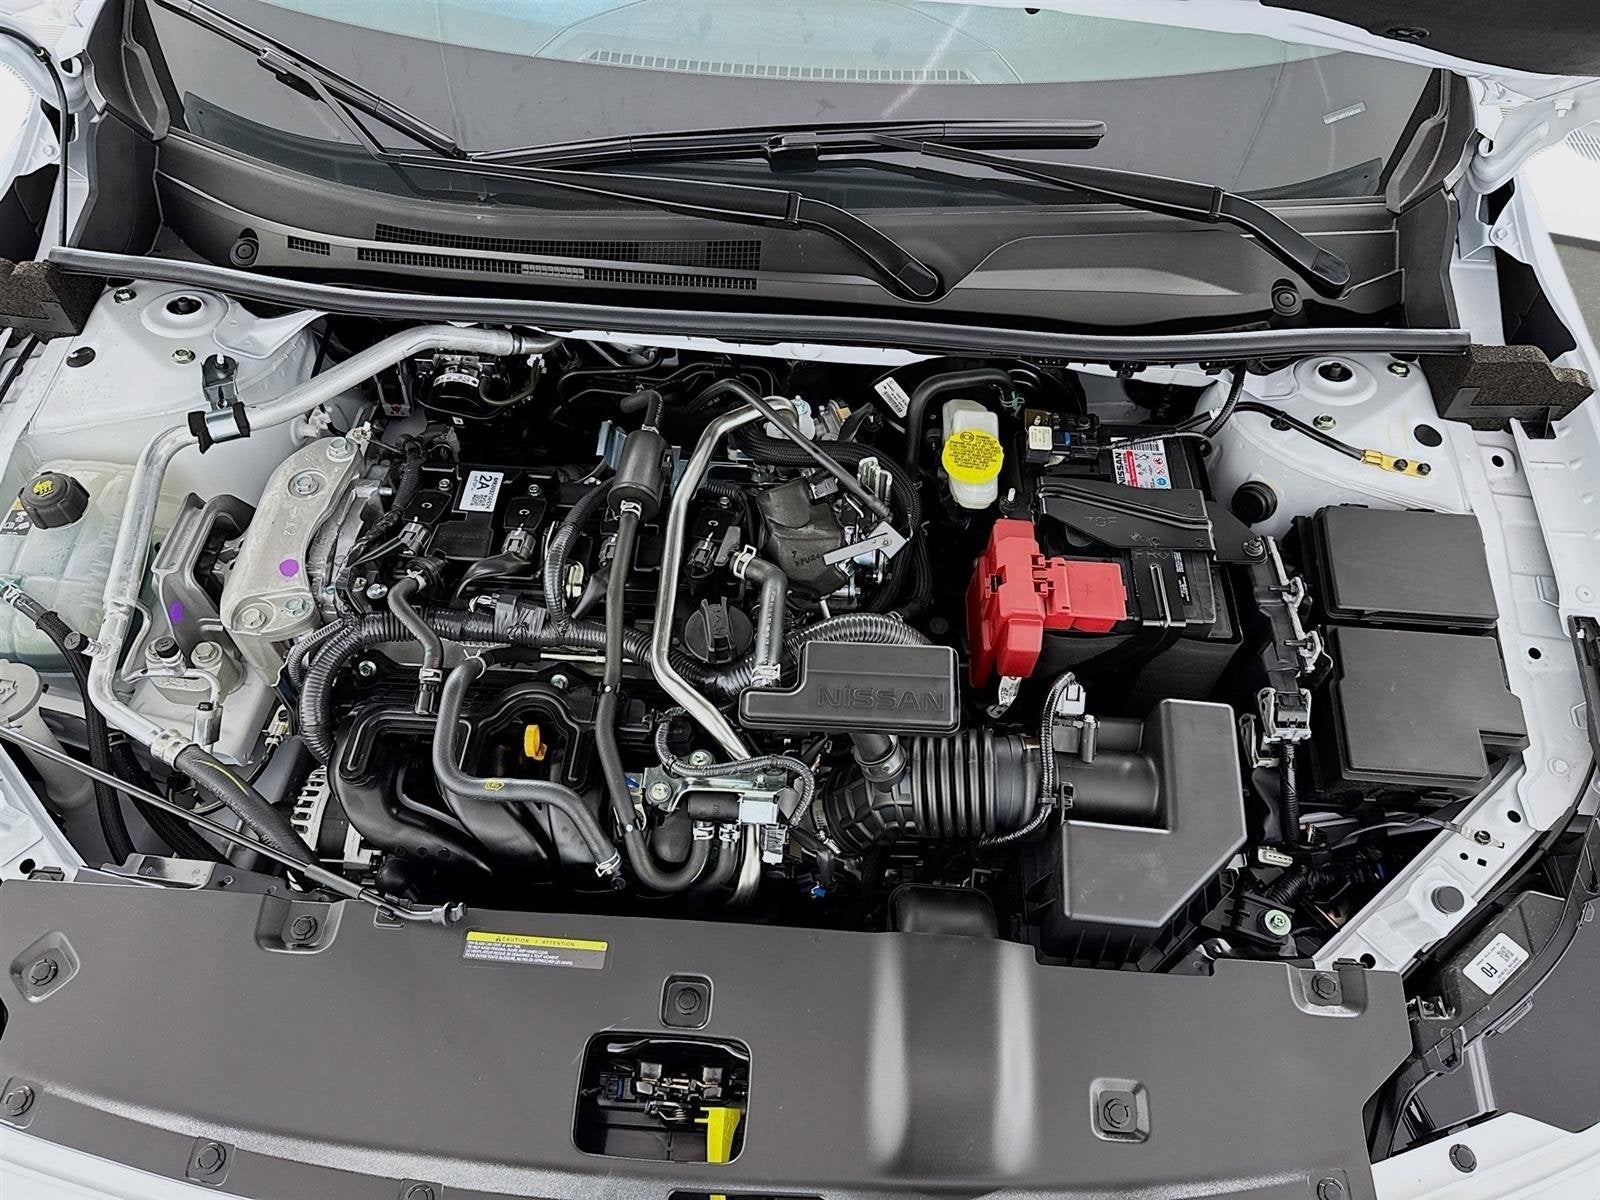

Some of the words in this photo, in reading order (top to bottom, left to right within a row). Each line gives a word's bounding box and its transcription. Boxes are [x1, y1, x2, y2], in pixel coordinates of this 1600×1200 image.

[1114, 452, 1126, 485] NISSAN
[476, 475, 493, 490] 2A
[817, 687, 945, 712] NISSAN
